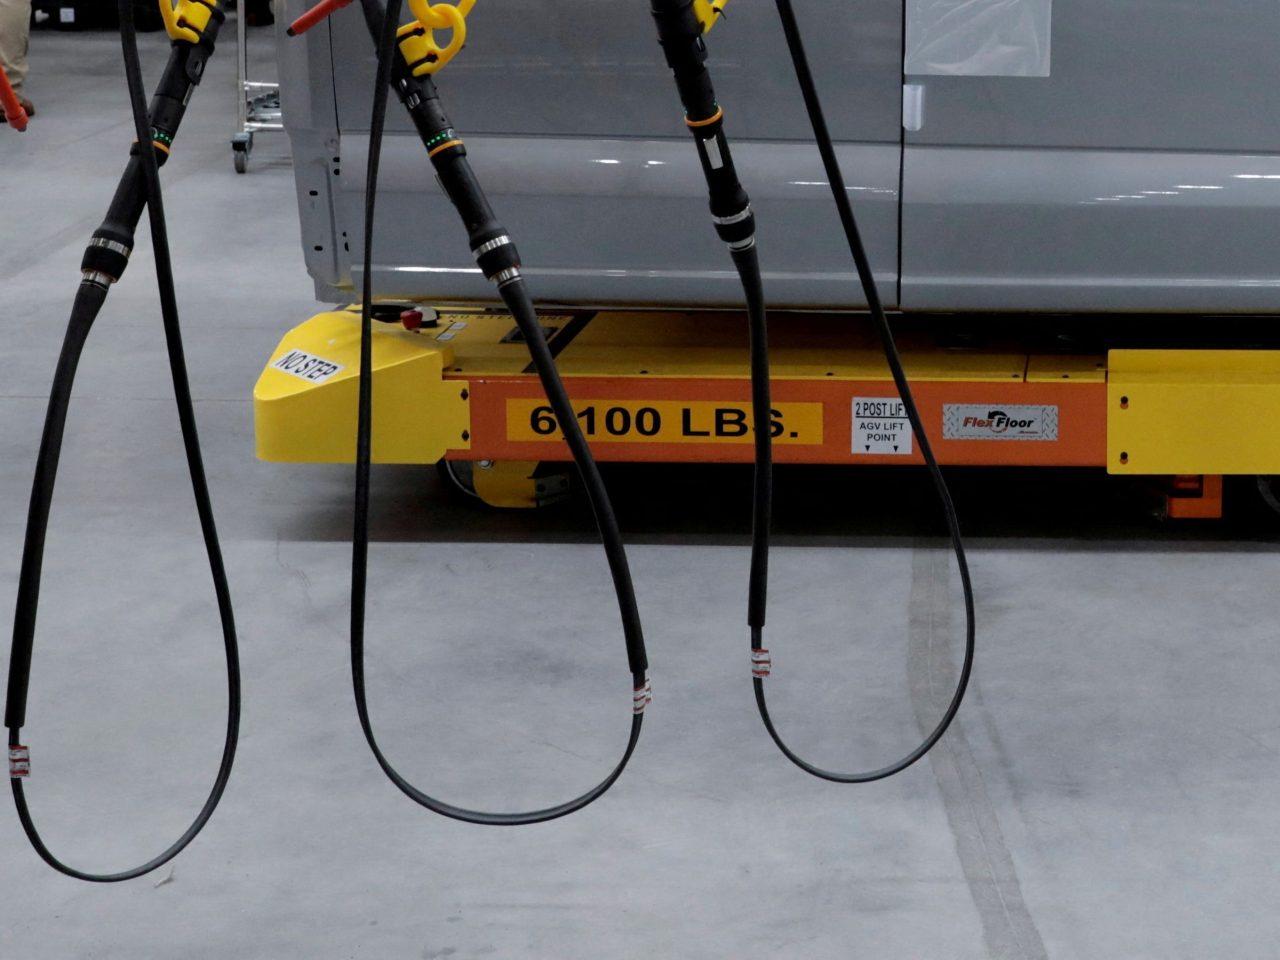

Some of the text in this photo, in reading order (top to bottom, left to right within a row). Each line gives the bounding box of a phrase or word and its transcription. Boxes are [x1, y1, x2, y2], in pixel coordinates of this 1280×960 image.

[275, 351, 338, 380] NO STEP
[855, 402, 861, 415] 2
[863, 402, 887, 416] POST
[530, 406, 661, 440] 6100
[859, 422, 905, 431] AGV LIFT
[866, 433, 898, 442] POINT
